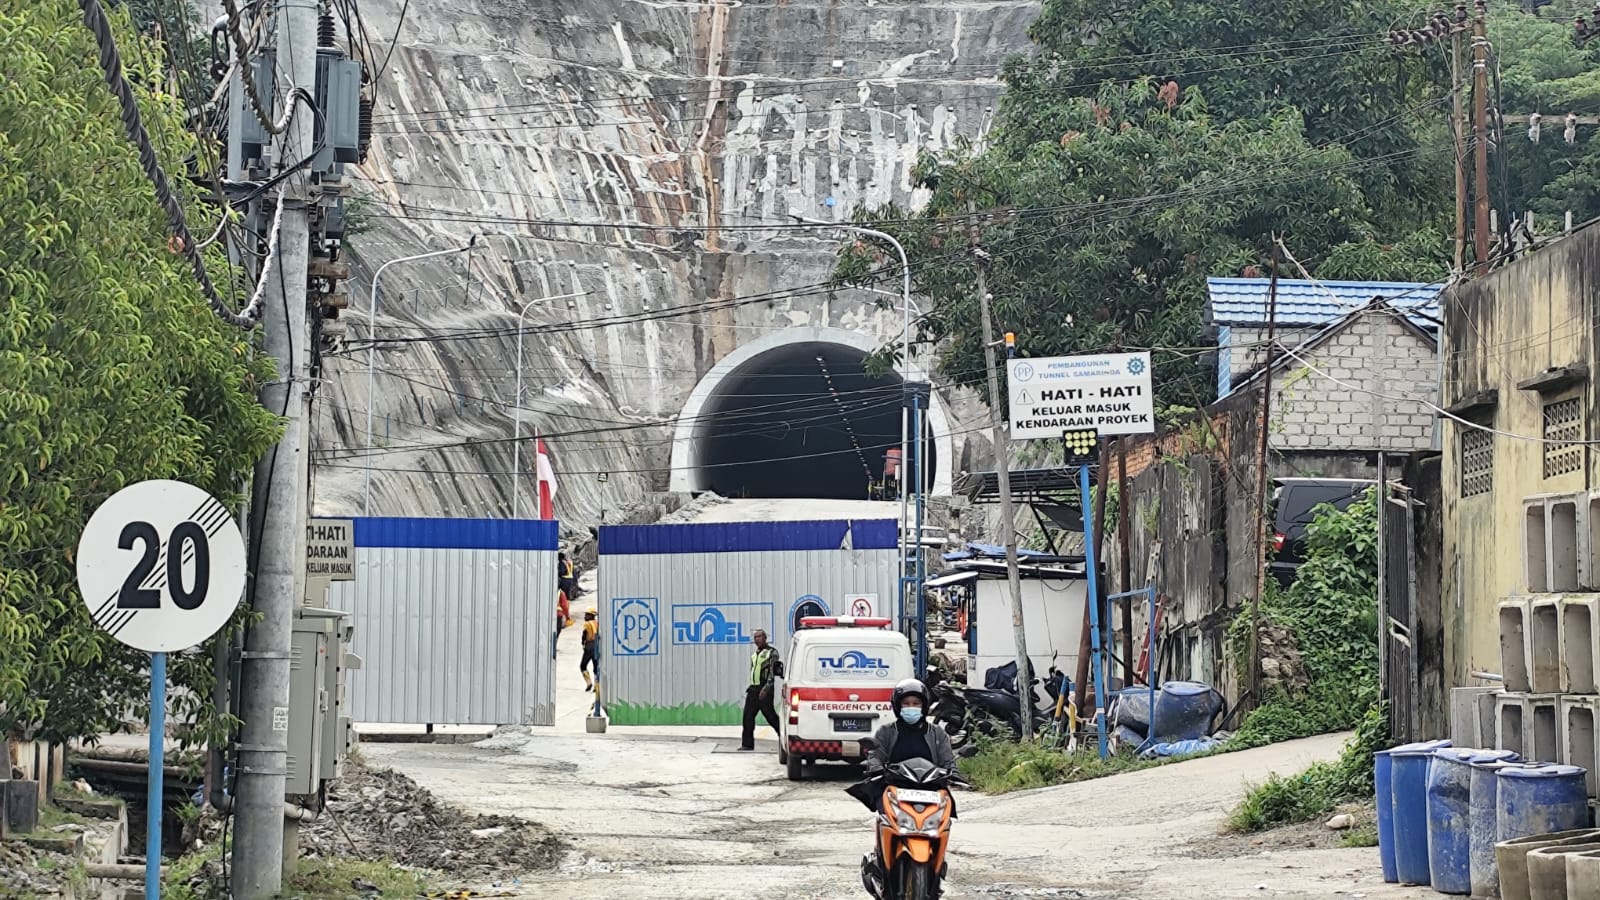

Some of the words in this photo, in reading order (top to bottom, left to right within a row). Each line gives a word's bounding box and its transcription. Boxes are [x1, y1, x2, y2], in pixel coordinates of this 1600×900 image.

[1047, 360, 1110, 369] PEMBANGUNAN
[1038, 371, 1070, 380] TUNNEL
[1041, 389, 1083, 401] HATI
[1100, 386, 1142, 398] HATI
[1032, 405, 1082, 416] KELUAR
[1086, 402, 1131, 413] MASUK
[1016, 417, 1093, 429] KENDARAAN
[1098, 414, 1148, 425] PROYEK
[117, 521, 210, 610] 20
[331, 562, 352, 574] MASUK
[811, 703, 872, 711] EMERGENCY
